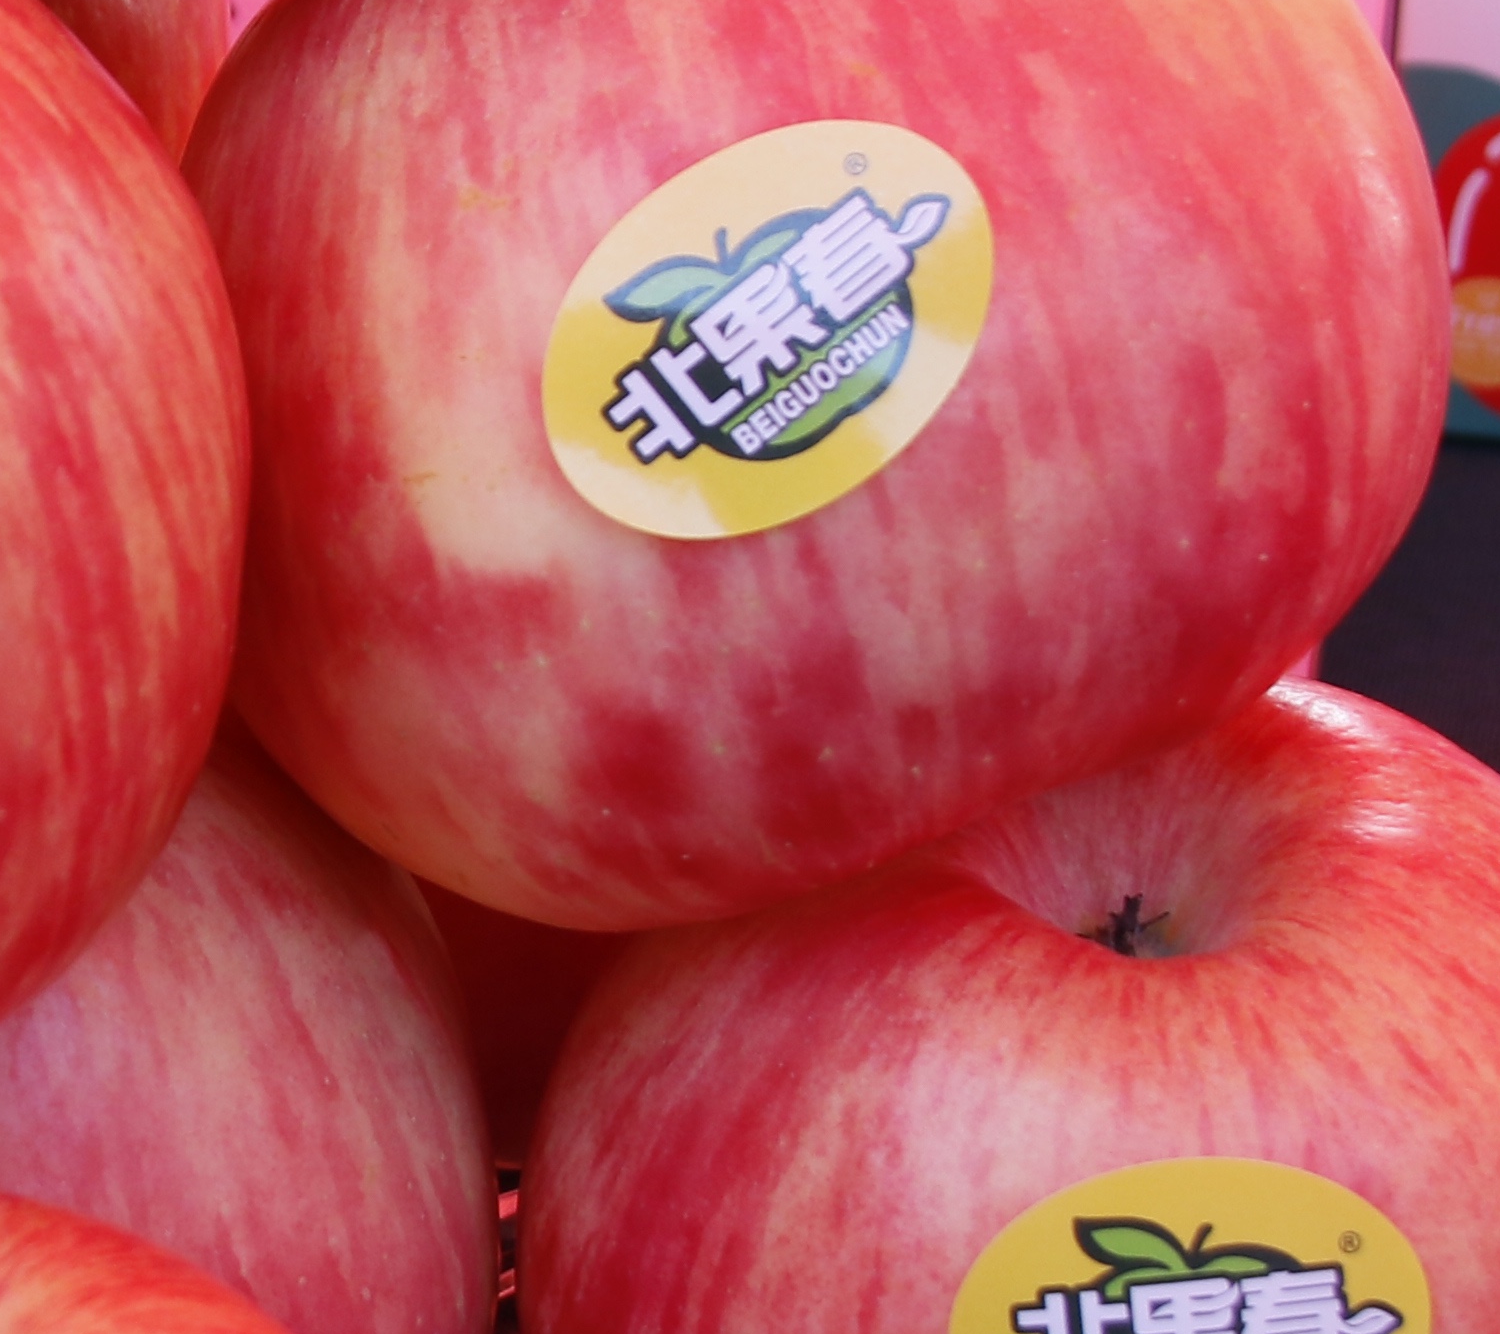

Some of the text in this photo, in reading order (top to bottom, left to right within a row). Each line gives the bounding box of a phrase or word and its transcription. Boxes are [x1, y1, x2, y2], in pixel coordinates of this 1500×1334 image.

[607, 195, 947, 458] 北果春
[730, 303, 910, 457] BEIGUOCHUN
